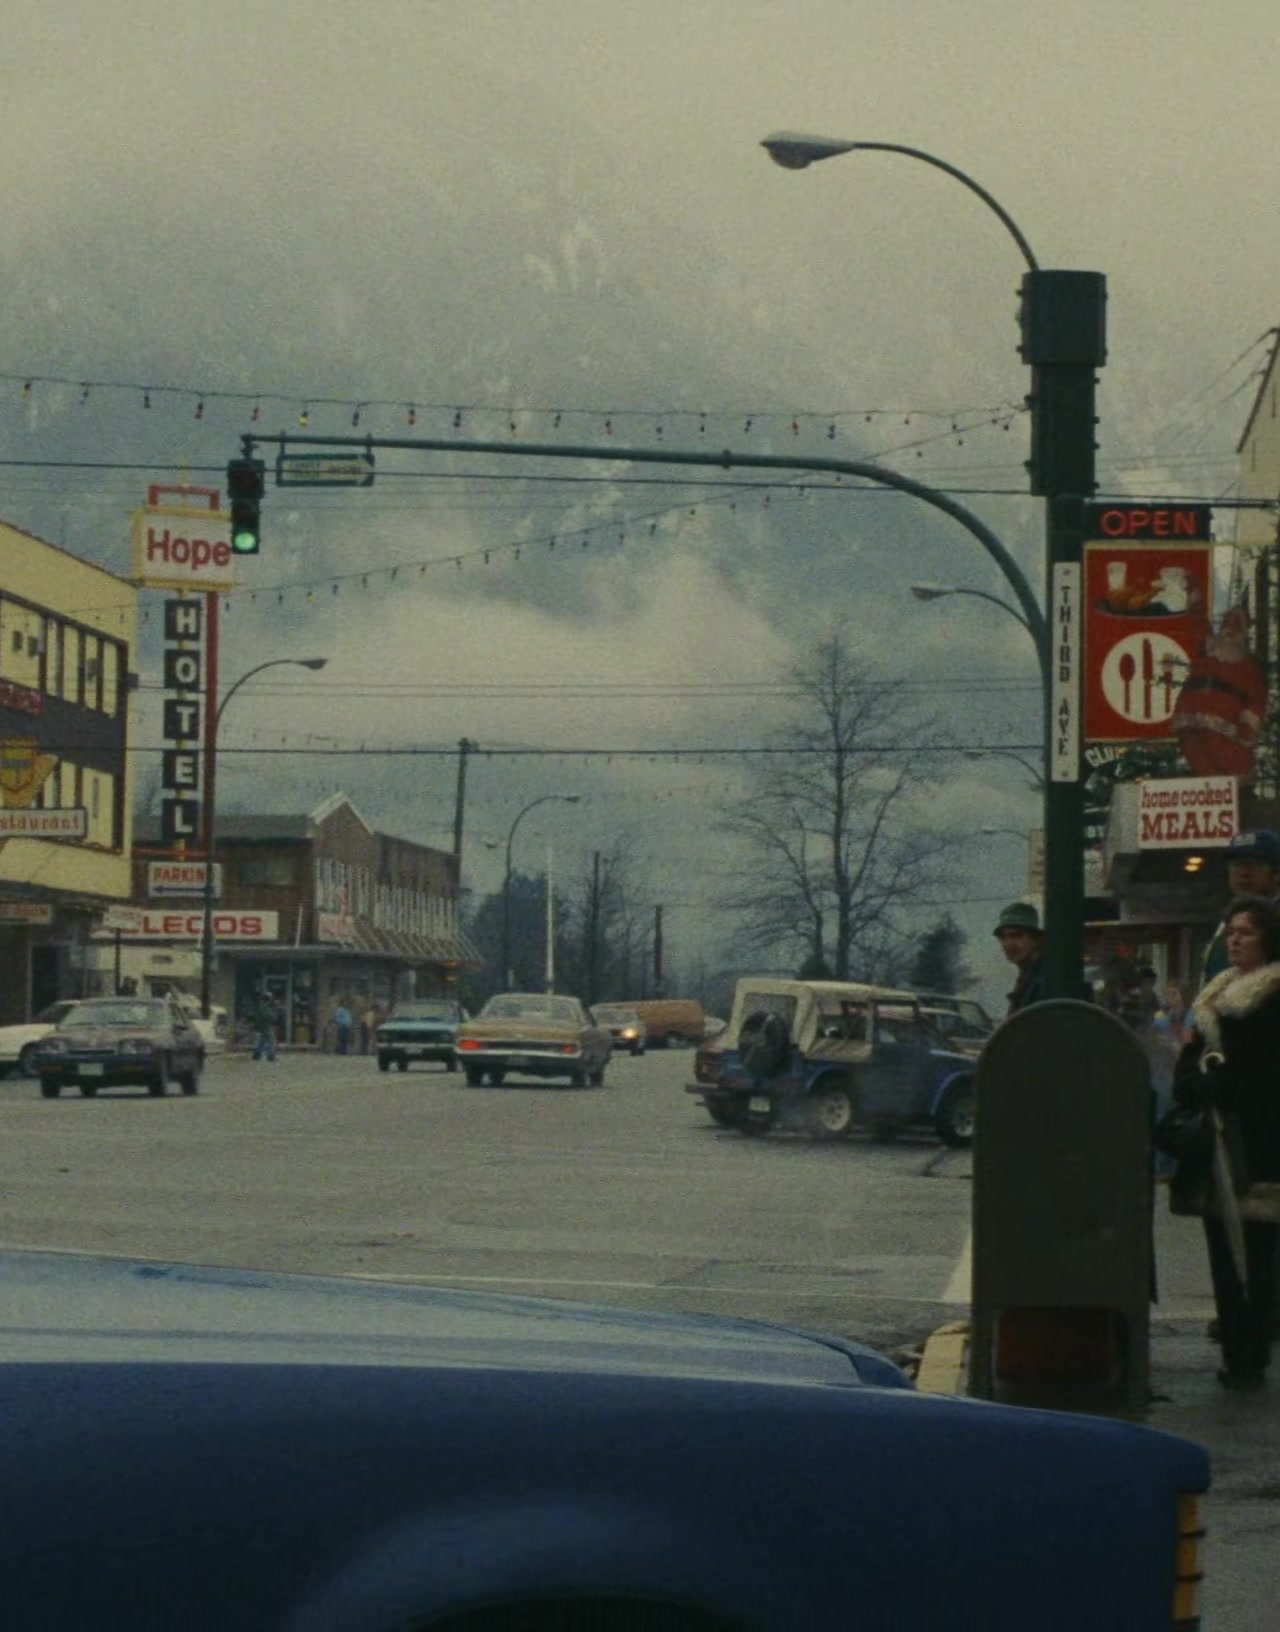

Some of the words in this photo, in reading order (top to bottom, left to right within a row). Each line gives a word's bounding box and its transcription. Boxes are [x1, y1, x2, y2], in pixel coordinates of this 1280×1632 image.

[1100, 509, 1197, 536] OPEN
[147, 529, 232, 570] Hope
[1058, 586, 1071, 683] THIRD
[173, 606, 199, 834] HOTEL
[1058, 697, 1070, 756] AVE
[1085, 746, 1126, 768] CLU
[1141, 786, 1179, 809] home
[1180, 781, 1233, 807] cooked
[1141, 810, 1234, 842] MEALS
[153, 868, 217, 883] PARKIN
